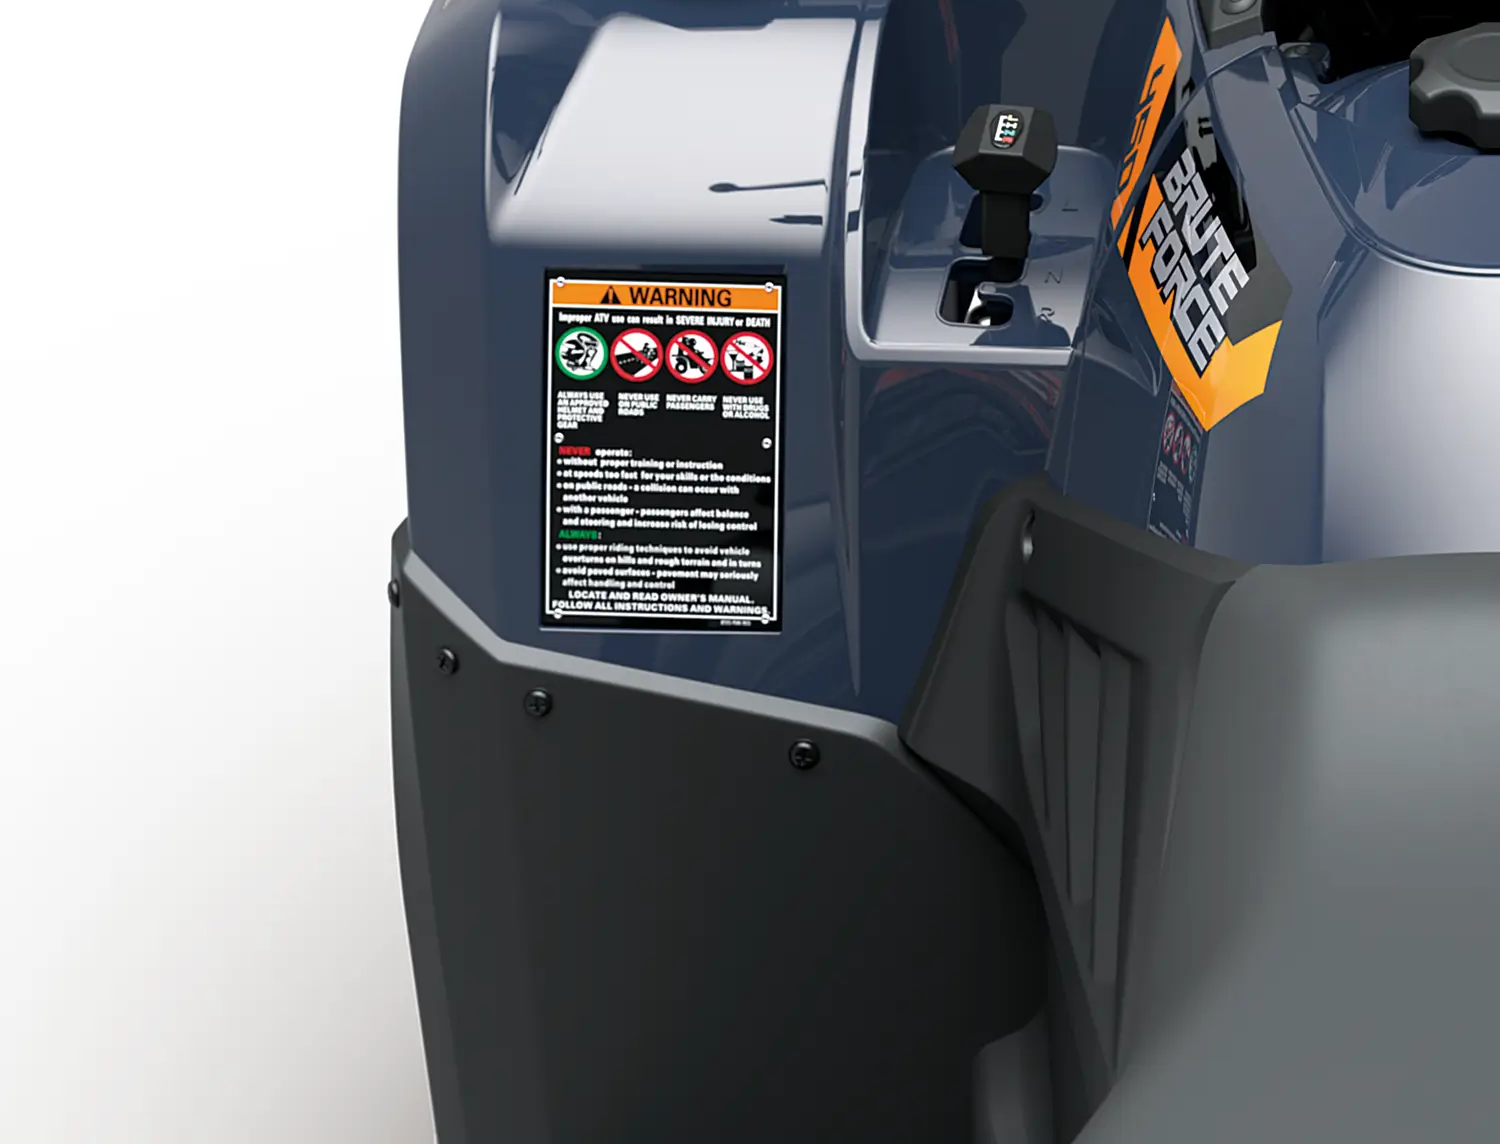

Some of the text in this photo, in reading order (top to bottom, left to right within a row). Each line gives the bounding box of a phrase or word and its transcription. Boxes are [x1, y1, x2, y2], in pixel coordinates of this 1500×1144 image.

[1162, 146, 1250, 316] BRUTE
[1139, 201, 1227, 373] FORCE
[629, 287, 731, 306] WARNING
[559, 312, 592, 324] Improper
[594, 313, 609, 323] ATV
[627, 316, 640, 324] can
[642, 314, 664, 324] result
[666, 315, 673, 324] in
[676, 315, 704, 325] SEVERE
[707, 316, 734, 326] INJURY
[746, 317, 770, 327] DEATH
[559, 446, 592, 456] NEVER
[569, 589, 607, 599] LOCATE
[609, 591, 630, 600] AND
[632, 591, 658, 601] READ
[552, 600, 593, 609] FOLLOW
[595, 601, 612, 610] ALL
[614, 601, 688, 612] INSTRUCTIONS
[690, 603, 712, 613] AND
